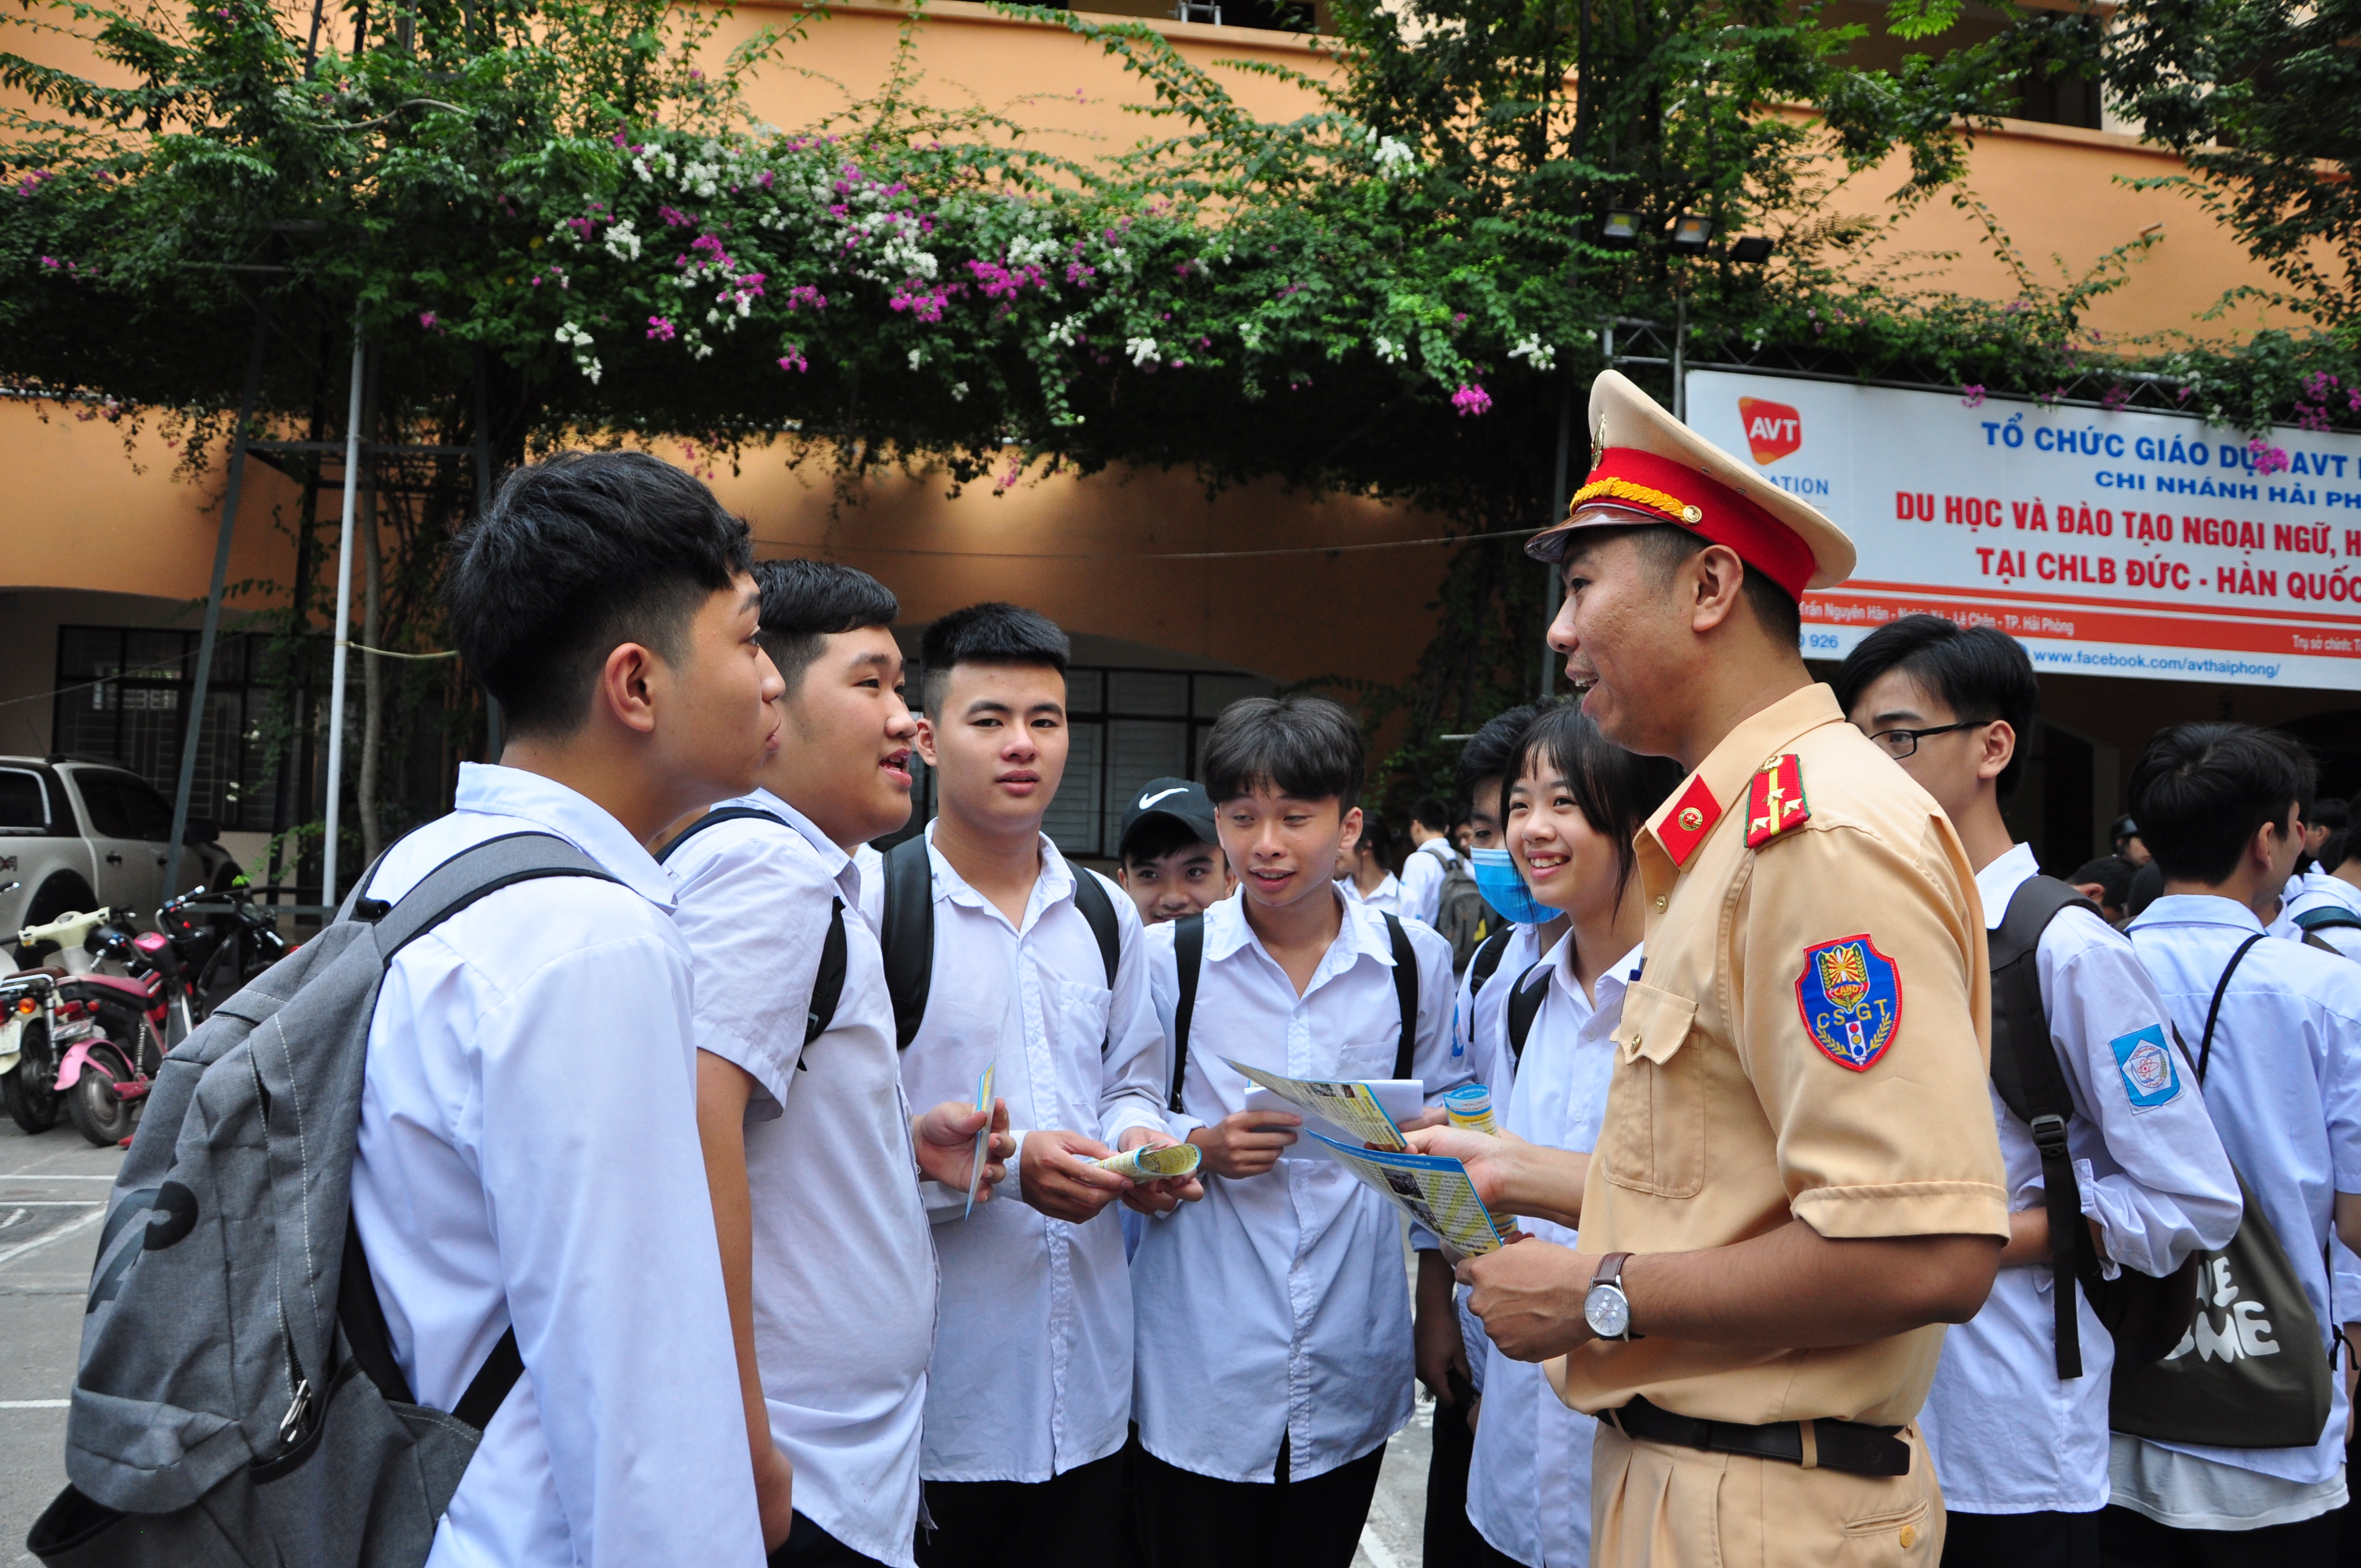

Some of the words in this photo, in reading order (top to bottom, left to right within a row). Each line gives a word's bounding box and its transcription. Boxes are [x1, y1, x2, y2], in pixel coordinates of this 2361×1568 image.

[1748, 416, 1798, 442] AVT
[1982, 412, 2023, 448] TỔ
[2034, 426, 2125, 458] CHỨC
[2135, 434, 2209, 467] GIÁO
[2220, 445, 2281, 477] DỤ
[2291, 451, 2348, 478] AVT
[1760, 473, 1829, 494] ATION
[2095, 471, 2145, 490] CHI
[2156, 473, 2258, 500] NHÁNH
[2268, 482, 2316, 505] HẢI
[1896, 492, 1934, 522] DU
[1945, 496, 2002, 532] HỌC
[2012, 497, 2048, 531] VÀ
[2057, 501, 2113, 537] ĐÀO
[2121, 511, 2173, 546] TẠO
[2183, 516, 2264, 553] NGOẠI
[2274, 521, 2336, 558] NGỮ,
[1976, 547, 2026, 584] TẠI
[2037, 552, 2117, 584] CHLB
[2126, 554, 2190, 590] ĐỨC
[2217, 560, 2276, 596] HÀN
[2287, 565, 2361, 603] QUỐC
[1825, 602, 1866, 622] Nguyên
[2023, 615, 2041, 630] Hải
[2042, 617, 2075, 637] Phòng
[1810, 634, 1838, 648] 926
[2033, 650, 2281, 678] www.facebook.com/avthaiphong/
[1834, 984, 1859, 997] CAND
[2163, 1300, 2281, 1363] ME
